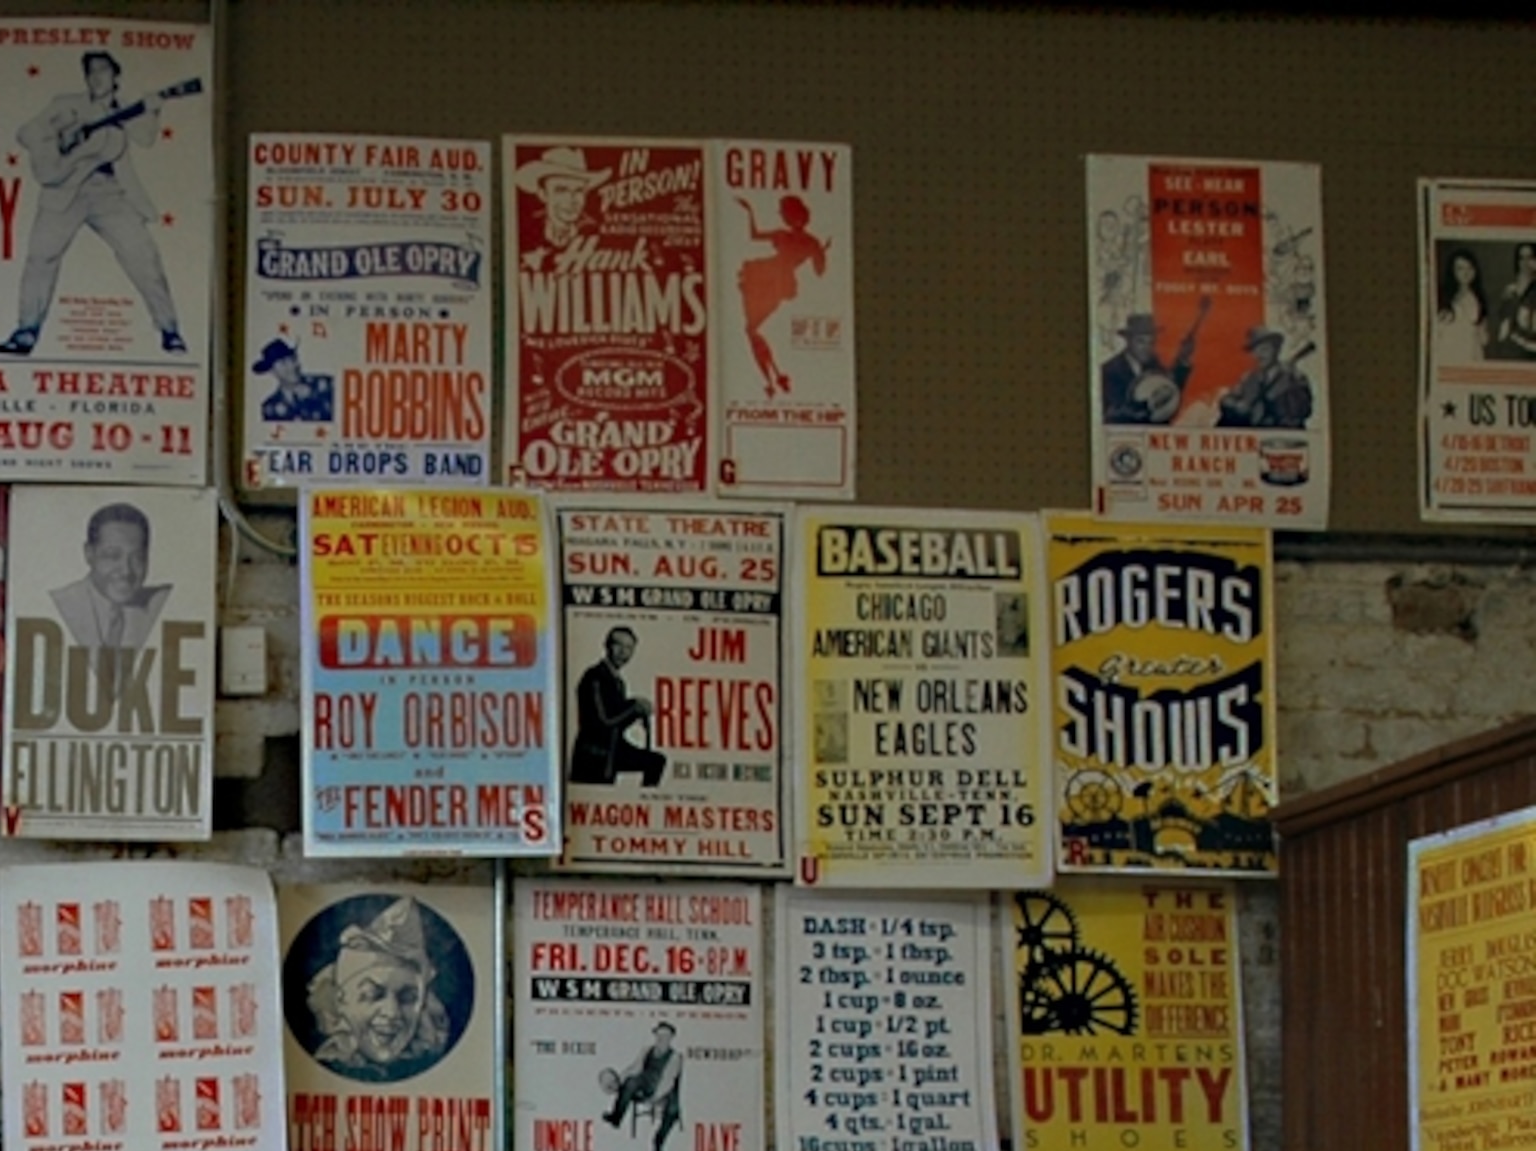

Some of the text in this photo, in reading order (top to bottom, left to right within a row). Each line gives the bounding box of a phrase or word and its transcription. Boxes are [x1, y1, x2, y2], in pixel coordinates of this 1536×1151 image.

[122, 31, 195, 49] SHOW
[726, 149, 837, 192] GRAVY
[258, 189, 482, 211] SUN. JULY 30
[1169, 220, 1244, 237] LESTER
[519, 271, 706, 335] WILLIAMS
[365, 323, 468, 365] MARTY
[34, 371, 195, 397] THEATRE
[582, 370, 664, 388] MGM
[342, 369, 484, 440] ROBBINS
[1469, 395, 1496, 426] US
[551, 419, 672, 448] GRAND
[329, 452, 483, 477] DROPS BAND
[1172, 456, 1237, 473] RANCH
[313, 496, 405, 519] AMERICAN
[1158, 495, 1302, 515] SUN APR 25
[571, 515, 770, 537] STATE THEATRE
[821, 527, 1020, 575] BASEBALL
[568, 553, 775, 582] SUN. AUG. 25
[857, 593, 946, 622] CHICAGO
[1054, 564, 1252, 645] ROGERS
[338, 618, 516, 665] DANCE
[689, 628, 746, 662] JIM
[15, 618, 206, 734] DUKE
[853, 679, 1028, 714] NEW ORLEANS
[315, 691, 543, 749] ROY ORBISON
[655, 677, 774, 751] REEVES
[1060, 674, 1249, 774] SHOWS
[875, 722, 976, 757] EAGLES
[11, 741, 200, 816] ELLINGTON
[804, 917, 956, 940] DASH 1/4 tsp.
[24, 959, 117, 974] morphine
[900, 969, 964, 985] ounce
[913, 1065, 959, 1086] pint
[1024, 1067, 1232, 1123] UTILITY
[1025, 1129, 1236, 1148] SHOES
